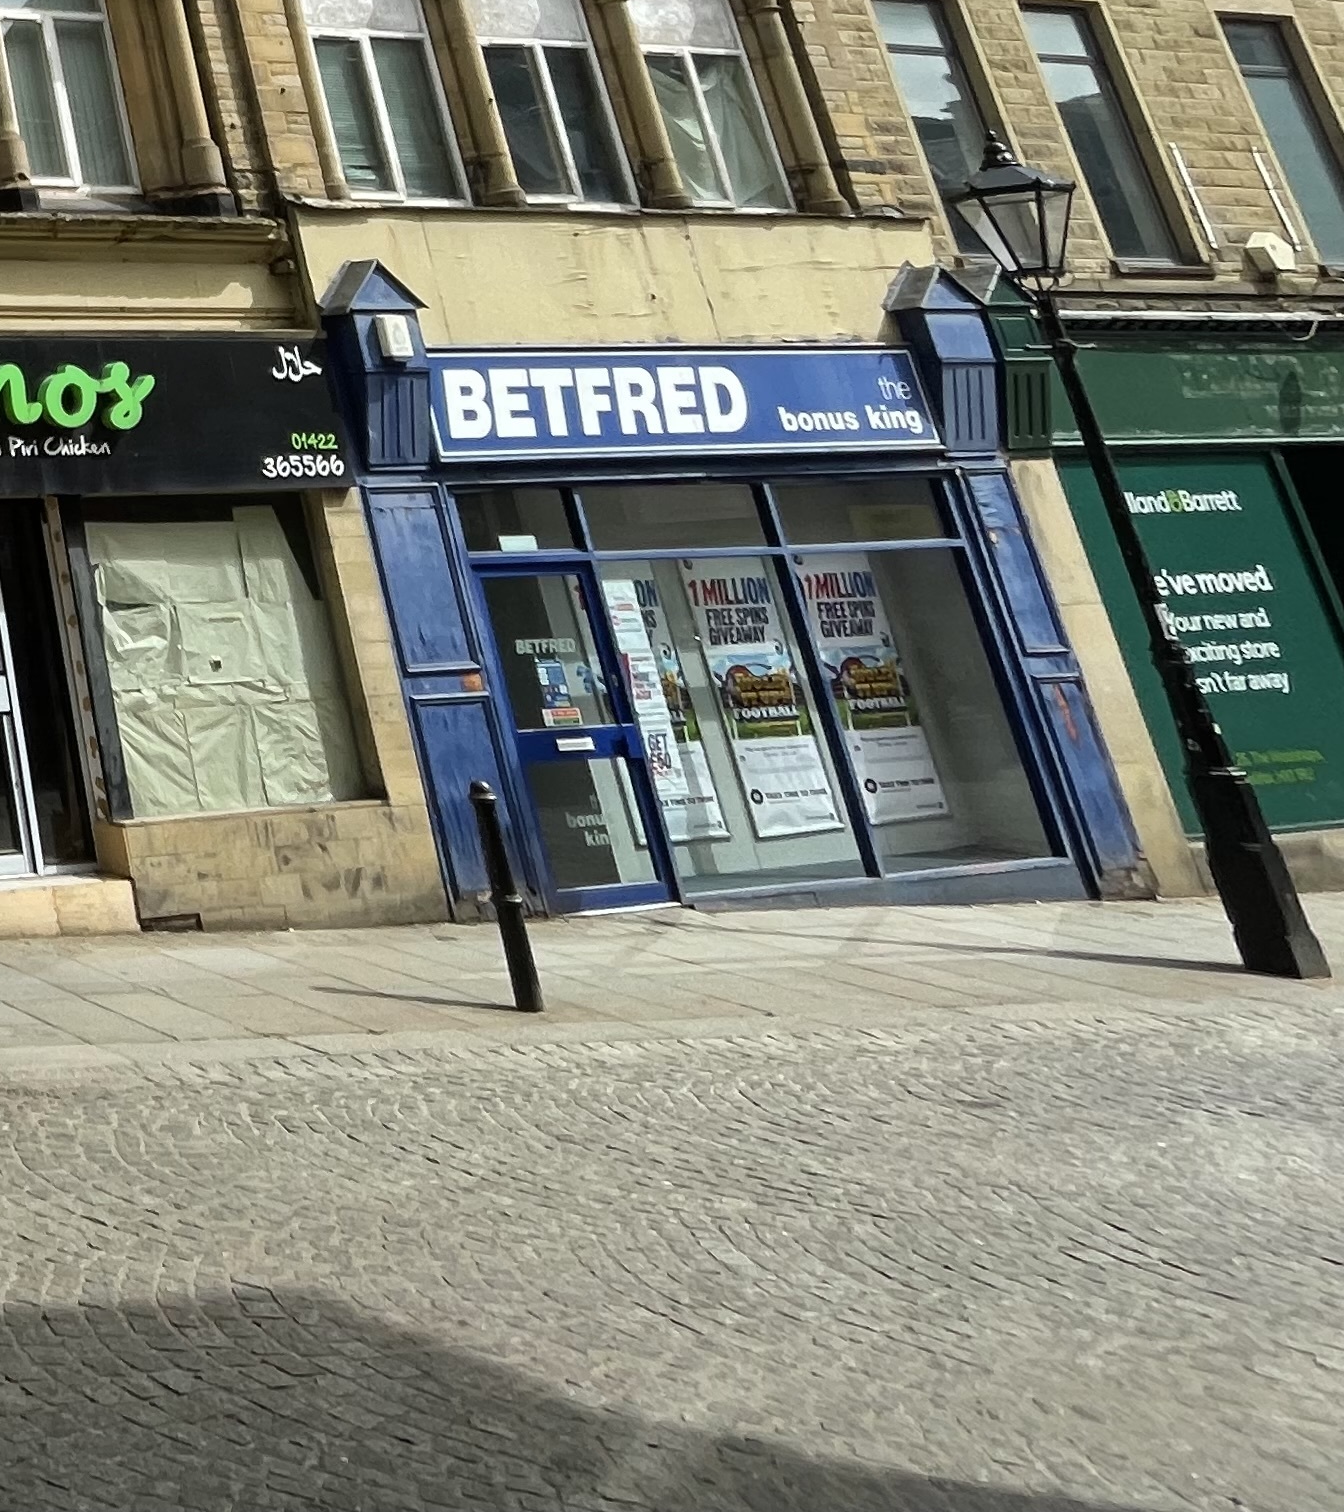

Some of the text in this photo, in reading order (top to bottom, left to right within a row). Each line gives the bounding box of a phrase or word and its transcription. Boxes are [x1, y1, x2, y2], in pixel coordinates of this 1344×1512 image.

[272, 345, 323, 383] حلال
[877, 375, 913, 401] the
[441, 365, 748, 439] BETFRED
[776, 404, 924, 434] bonus king
[8, 435, 39, 458] Piri
[43, 434, 112, 457] Chicken
[290, 431, 339, 450] 01422
[262, 453, 345, 478] 365566
[688, 578, 700, 607] 1
[702, 577, 772, 606] MILLION
[804, 571, 876, 600] 1 MILLION
[1153, 564, 1274, 597] e've moved
[705, 606, 770, 627] FREE SPINS
[816, 601, 848, 620] FREE
[1203, 613, 1239, 630] new
[1238, 607, 1272, 628] and
[515, 637, 577, 655] BETFRED
[708, 625, 767, 646] GIVEAWAY
[1243, 639, 1282, 659] store
[1222, 671, 1247, 692] far
[1247, 672, 1291, 694] away
[733, 704, 800, 721] FOOTBALL
